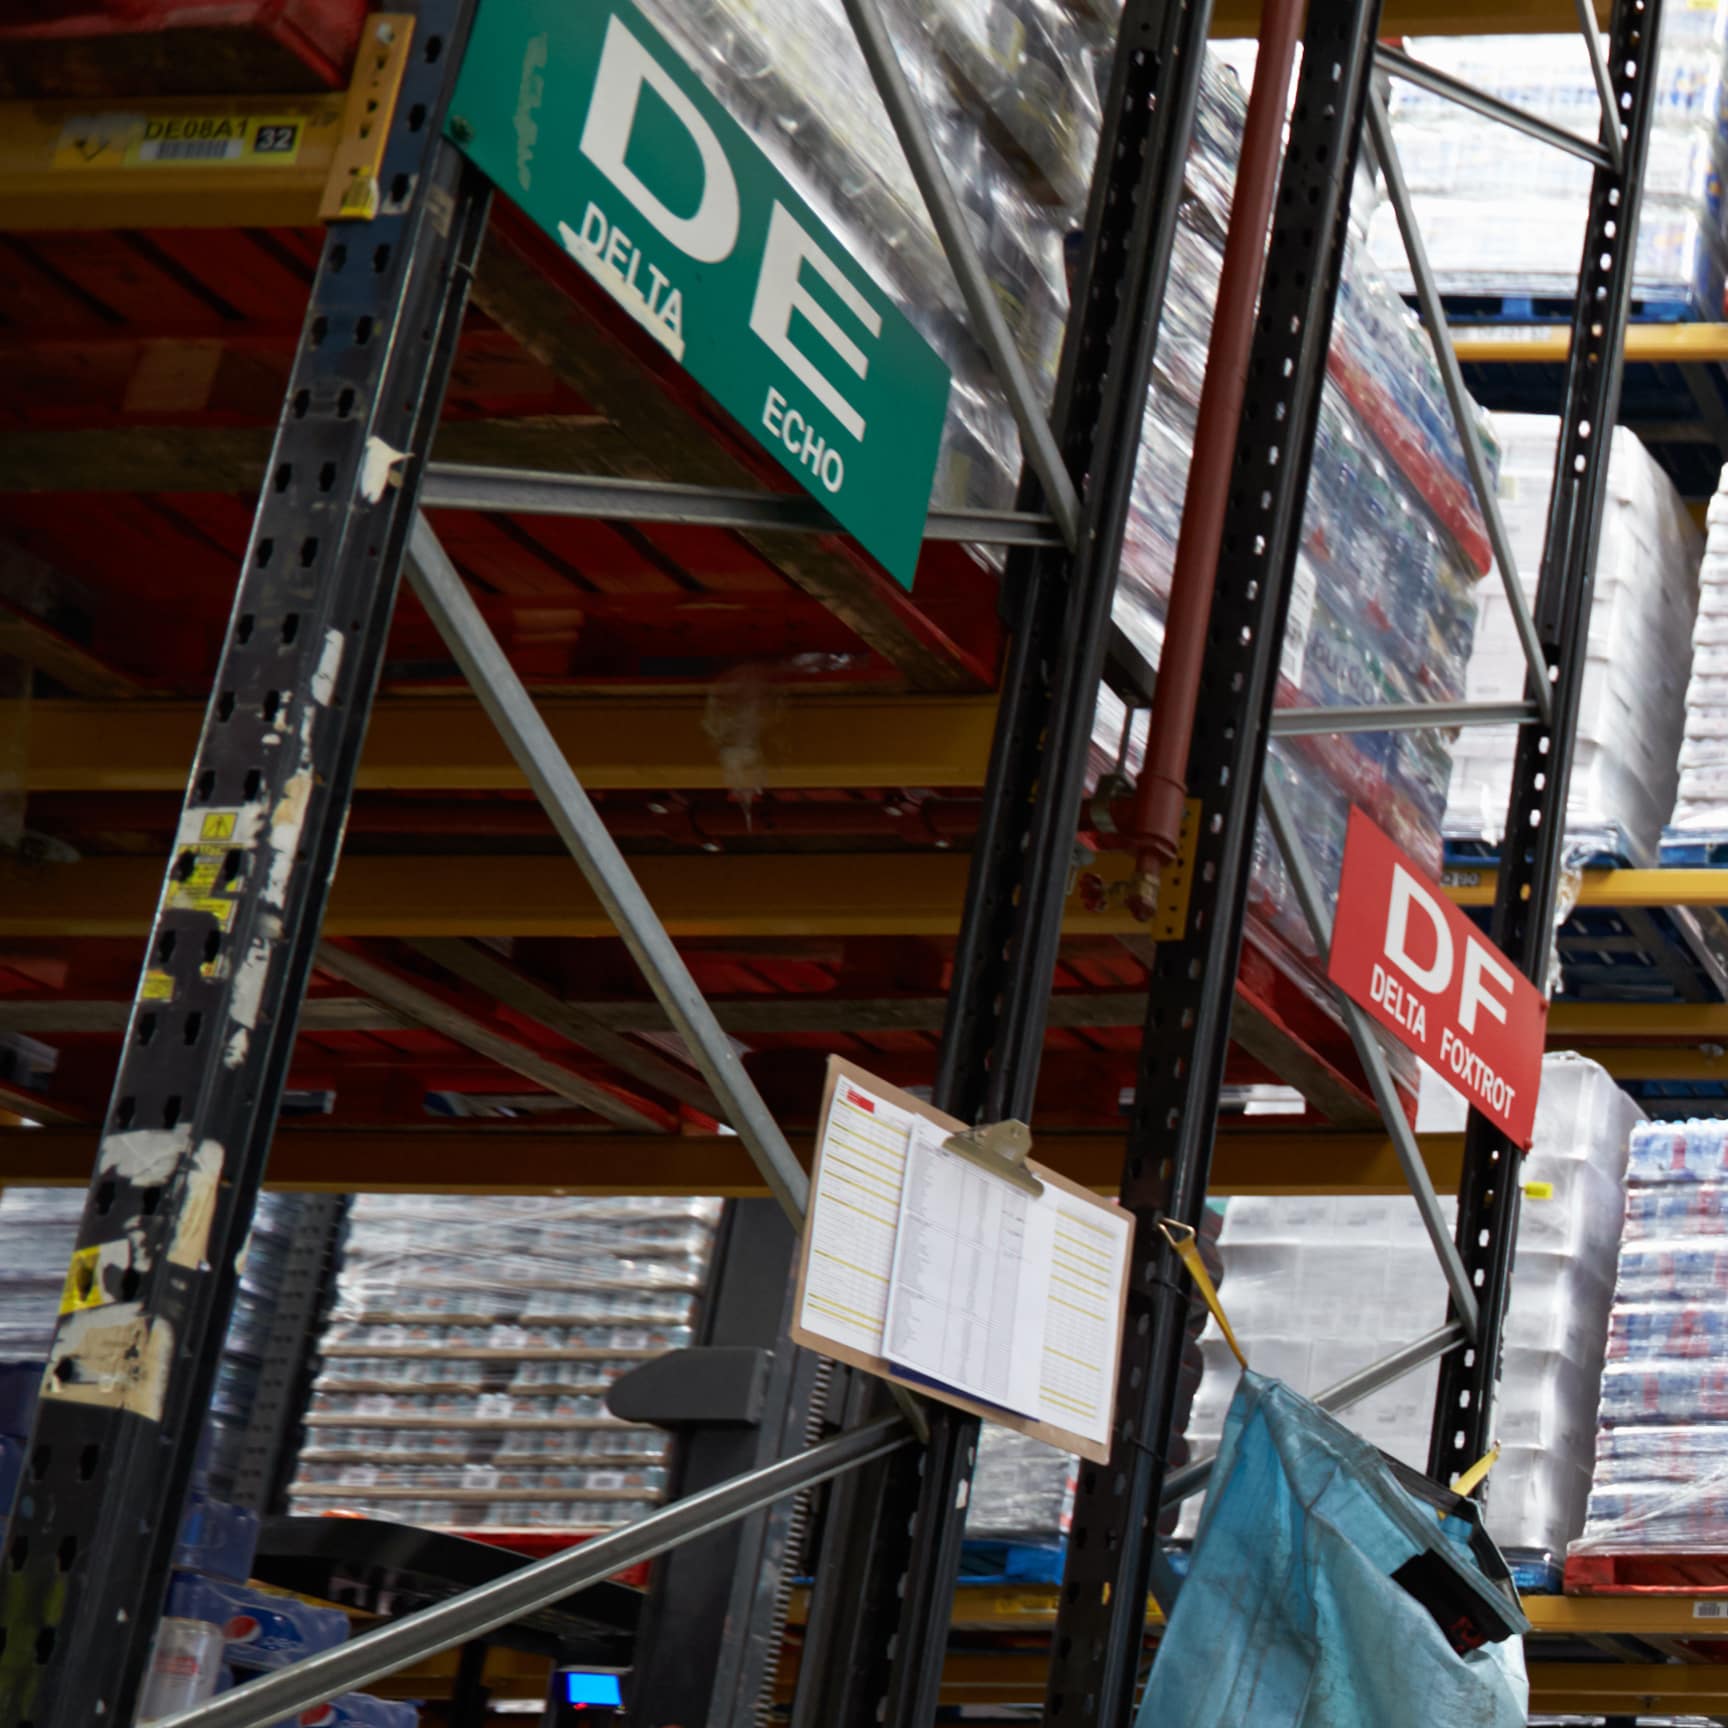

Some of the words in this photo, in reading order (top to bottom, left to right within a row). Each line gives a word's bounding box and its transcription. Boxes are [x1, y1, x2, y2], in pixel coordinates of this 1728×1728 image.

[146, 119, 246, 139] DE08A1
[257, 129, 292, 149] 32
[579, 13, 883, 442] DE
[580, 202, 685, 329] DELTA
[761, 385, 846, 494] ECHO
[1383, 863, 1515, 1035] DF
[1369, 963, 1427, 1045] DELTA
[1440, 1027, 1516, 1120] FOXTROT
